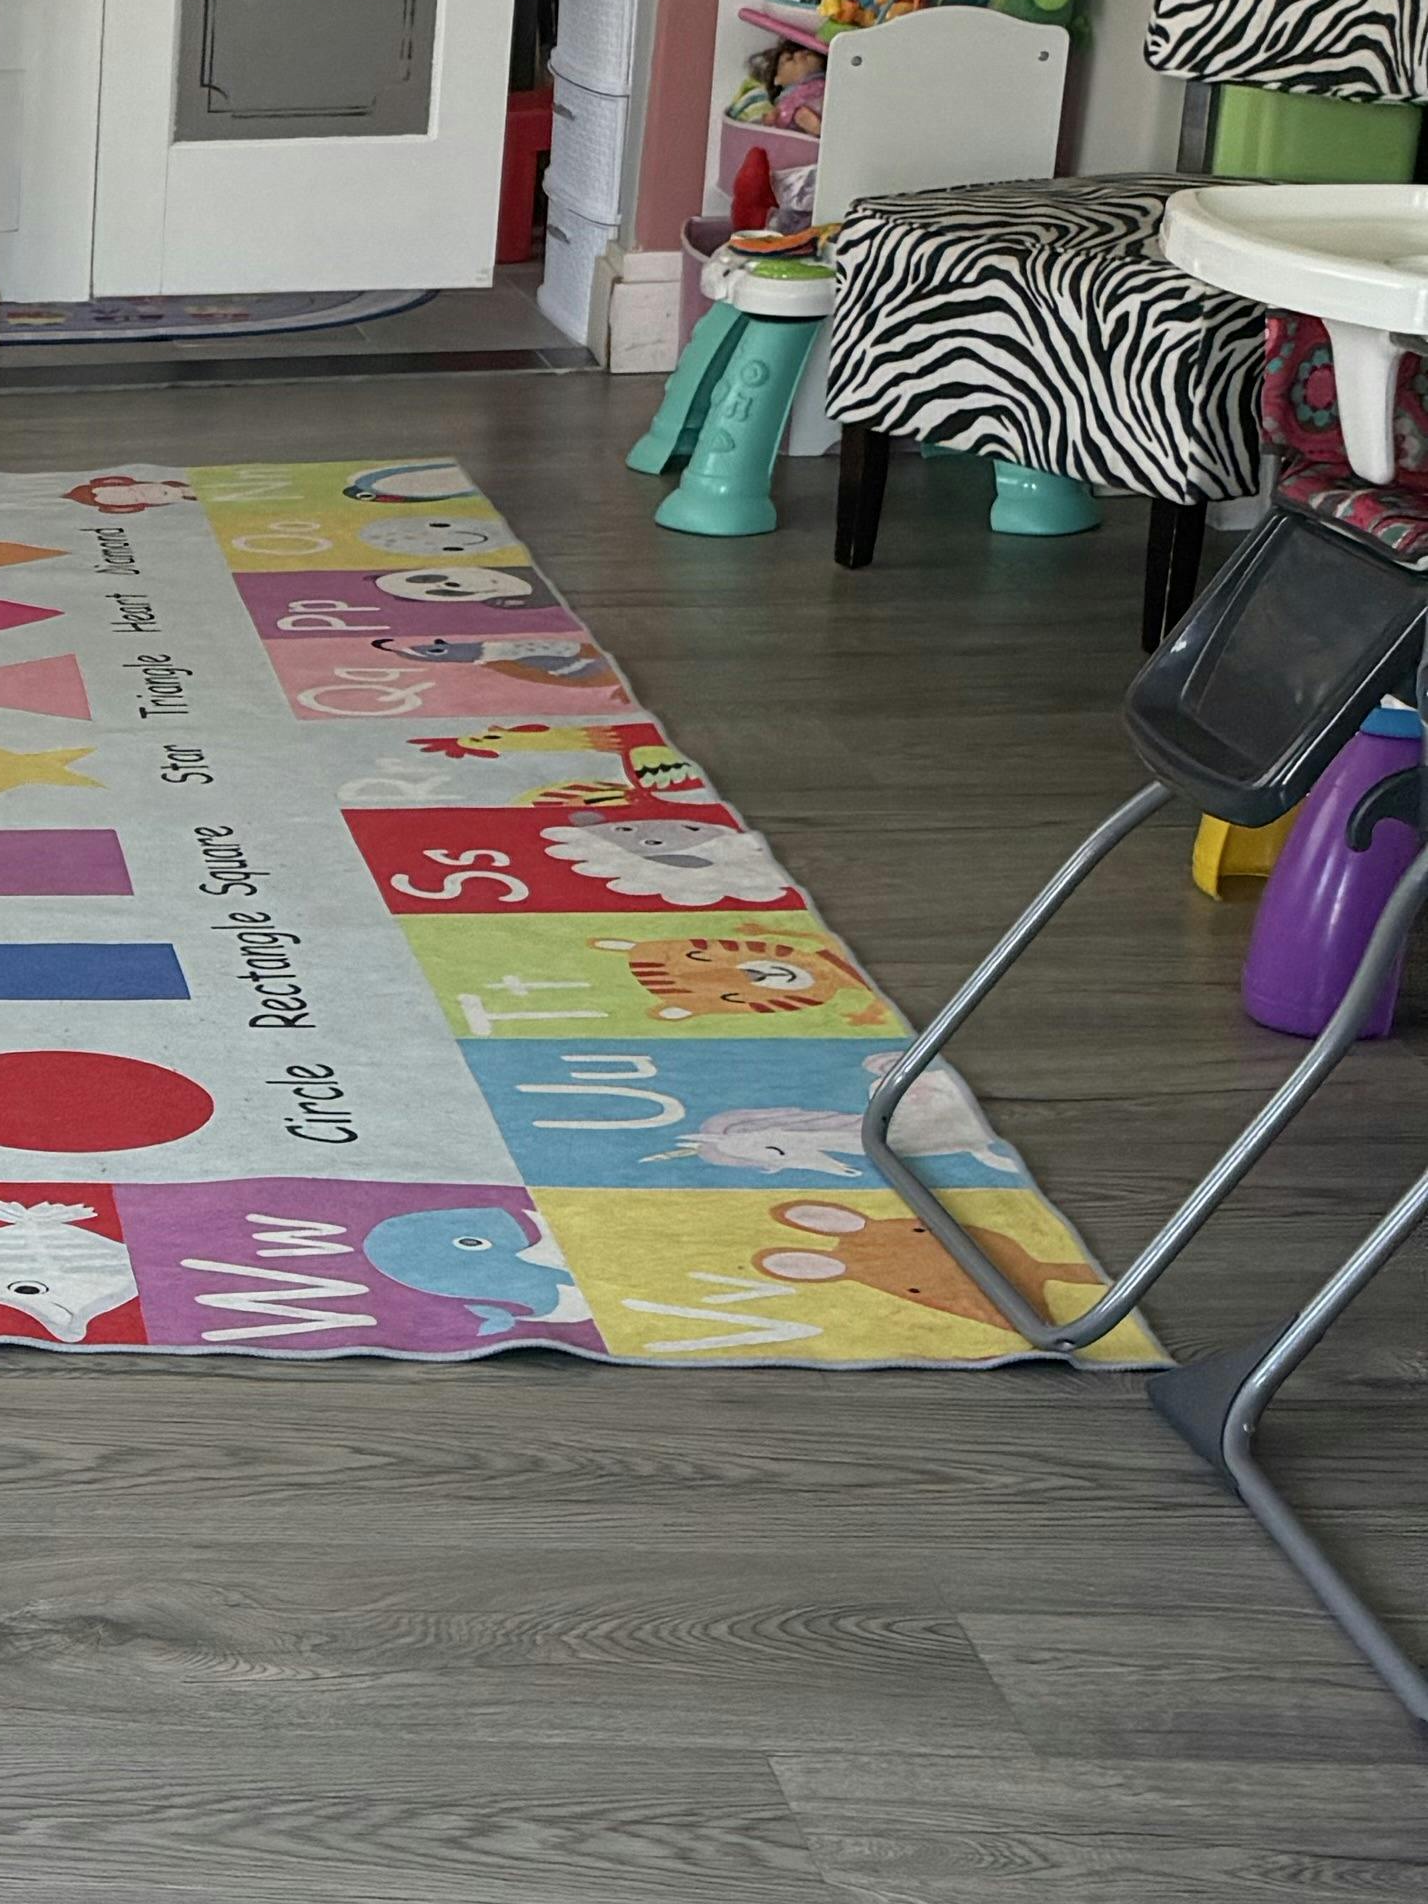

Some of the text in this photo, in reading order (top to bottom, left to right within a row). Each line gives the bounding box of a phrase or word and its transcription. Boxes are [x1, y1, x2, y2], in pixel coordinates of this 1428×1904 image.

[232, 522, 333, 557] Oo
[276, 599, 390, 631] Pp
[297, 667, 435, 716] Qq
[80, 527, 358, 1145] Circle Rectangle Square Star Triangle Heart Diamond
[391, 849, 529, 902] Ss
[459, 975, 609, 1036] Tt
[516, 1055, 685, 1130] Uu
[181, 1213, 378, 1342] Ww
[622, 1272, 824, 1351] Vv
